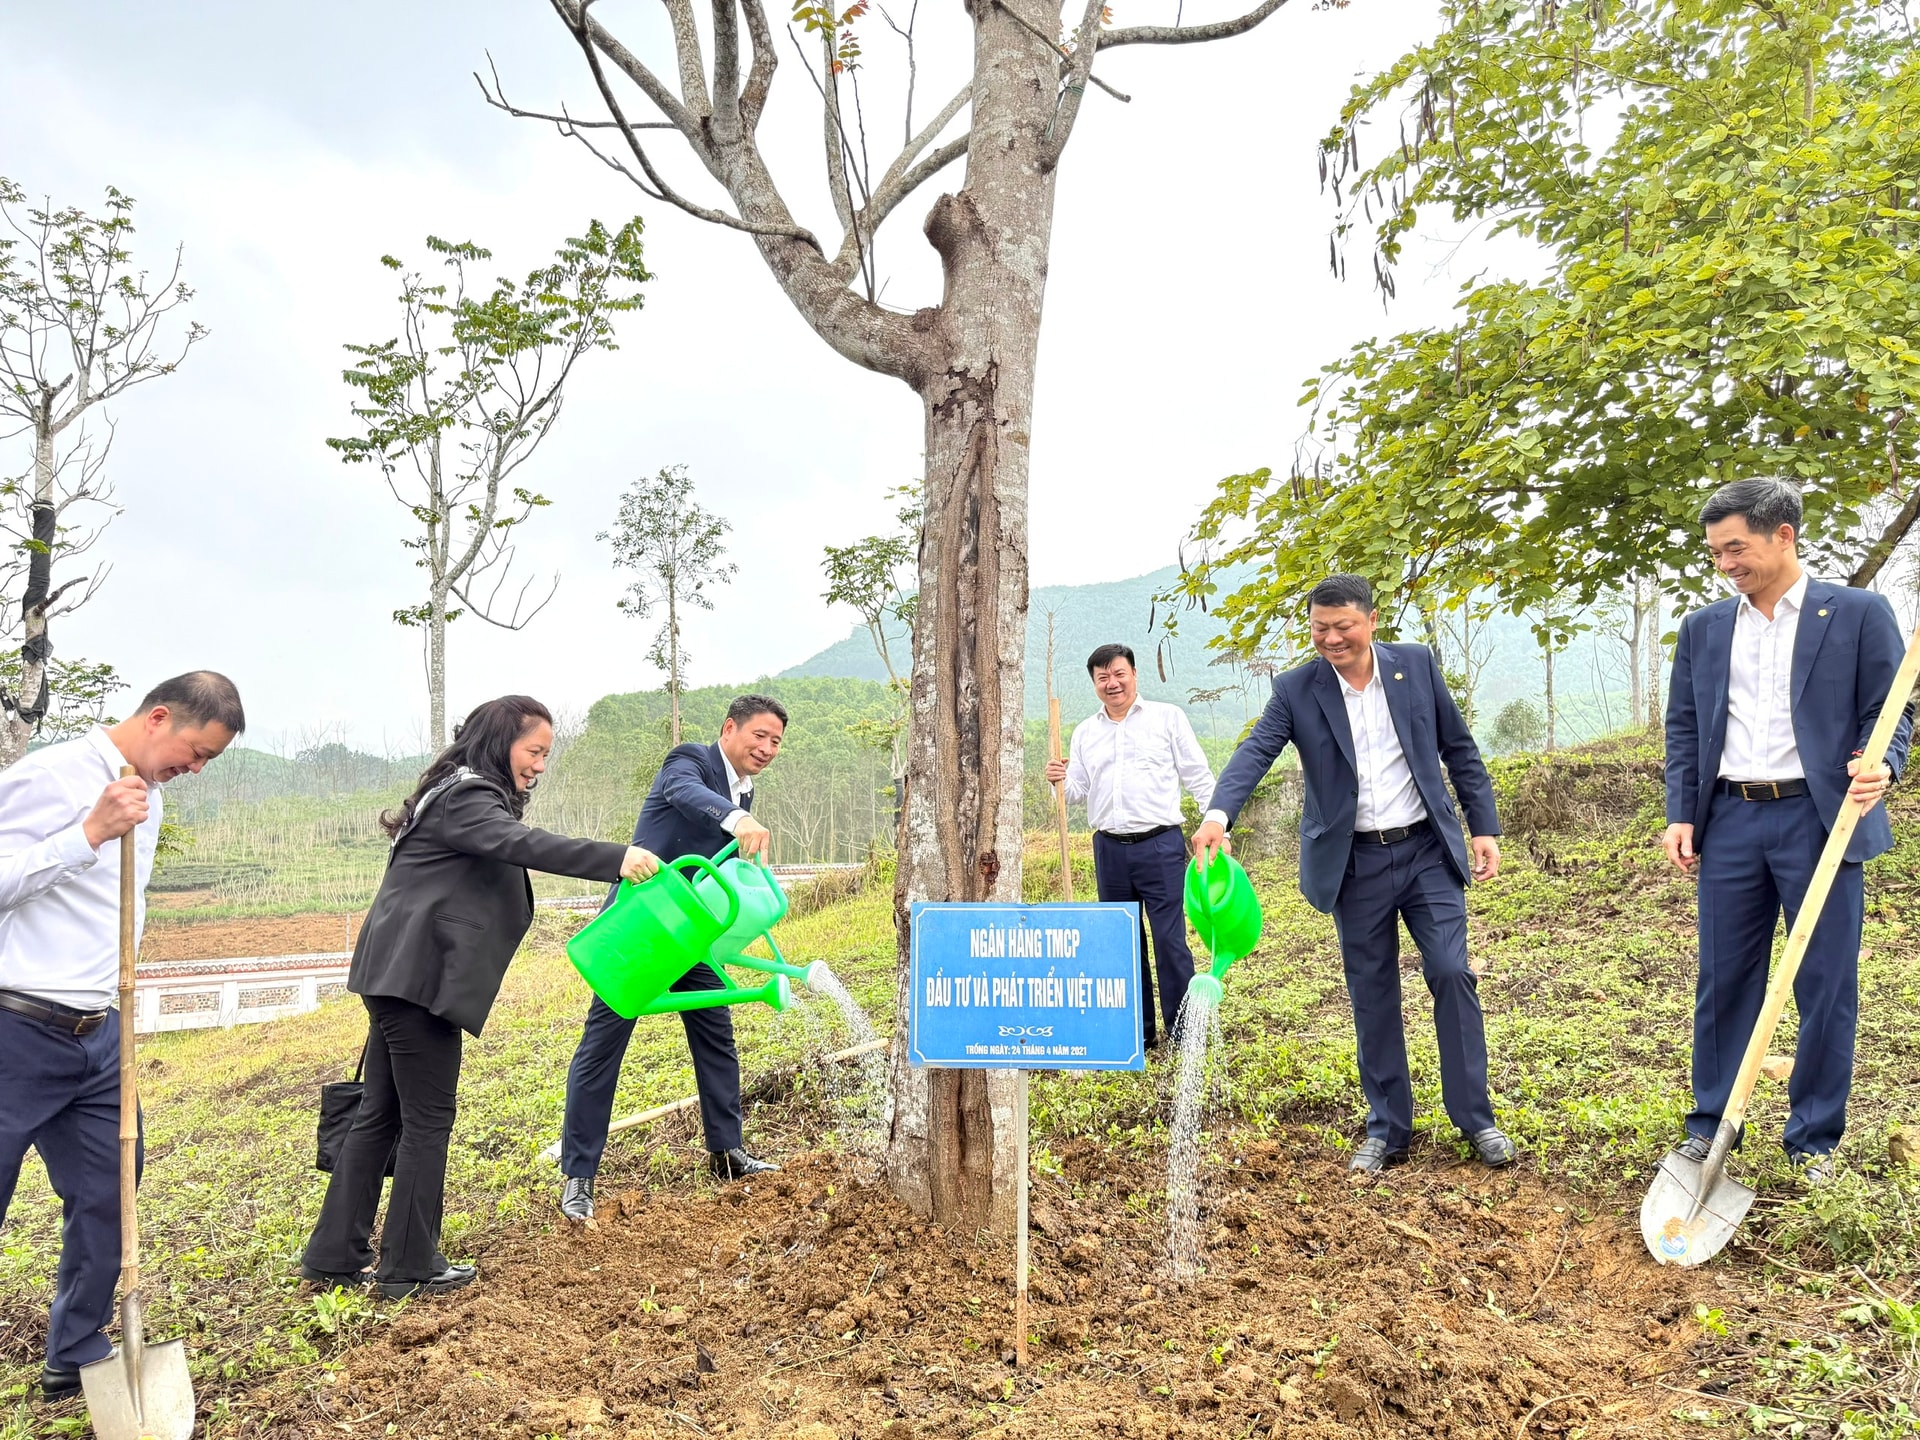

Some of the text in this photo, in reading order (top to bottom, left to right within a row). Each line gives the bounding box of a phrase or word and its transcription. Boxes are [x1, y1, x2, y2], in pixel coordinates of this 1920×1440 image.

[970, 922, 1080, 958] NGÂN HÀNG TMCP
[926, 965, 1126, 1015] ĐẦU TƯ VÀ PHÁT TRIỂN VIỆT NAM
[1011, 1045, 1021, 1055] 24
[1022, 1044, 1045, 1055] THÁNG
[1046, 1046, 1051, 1055] 4
[1070, 1046, 1087, 1056] 2021
